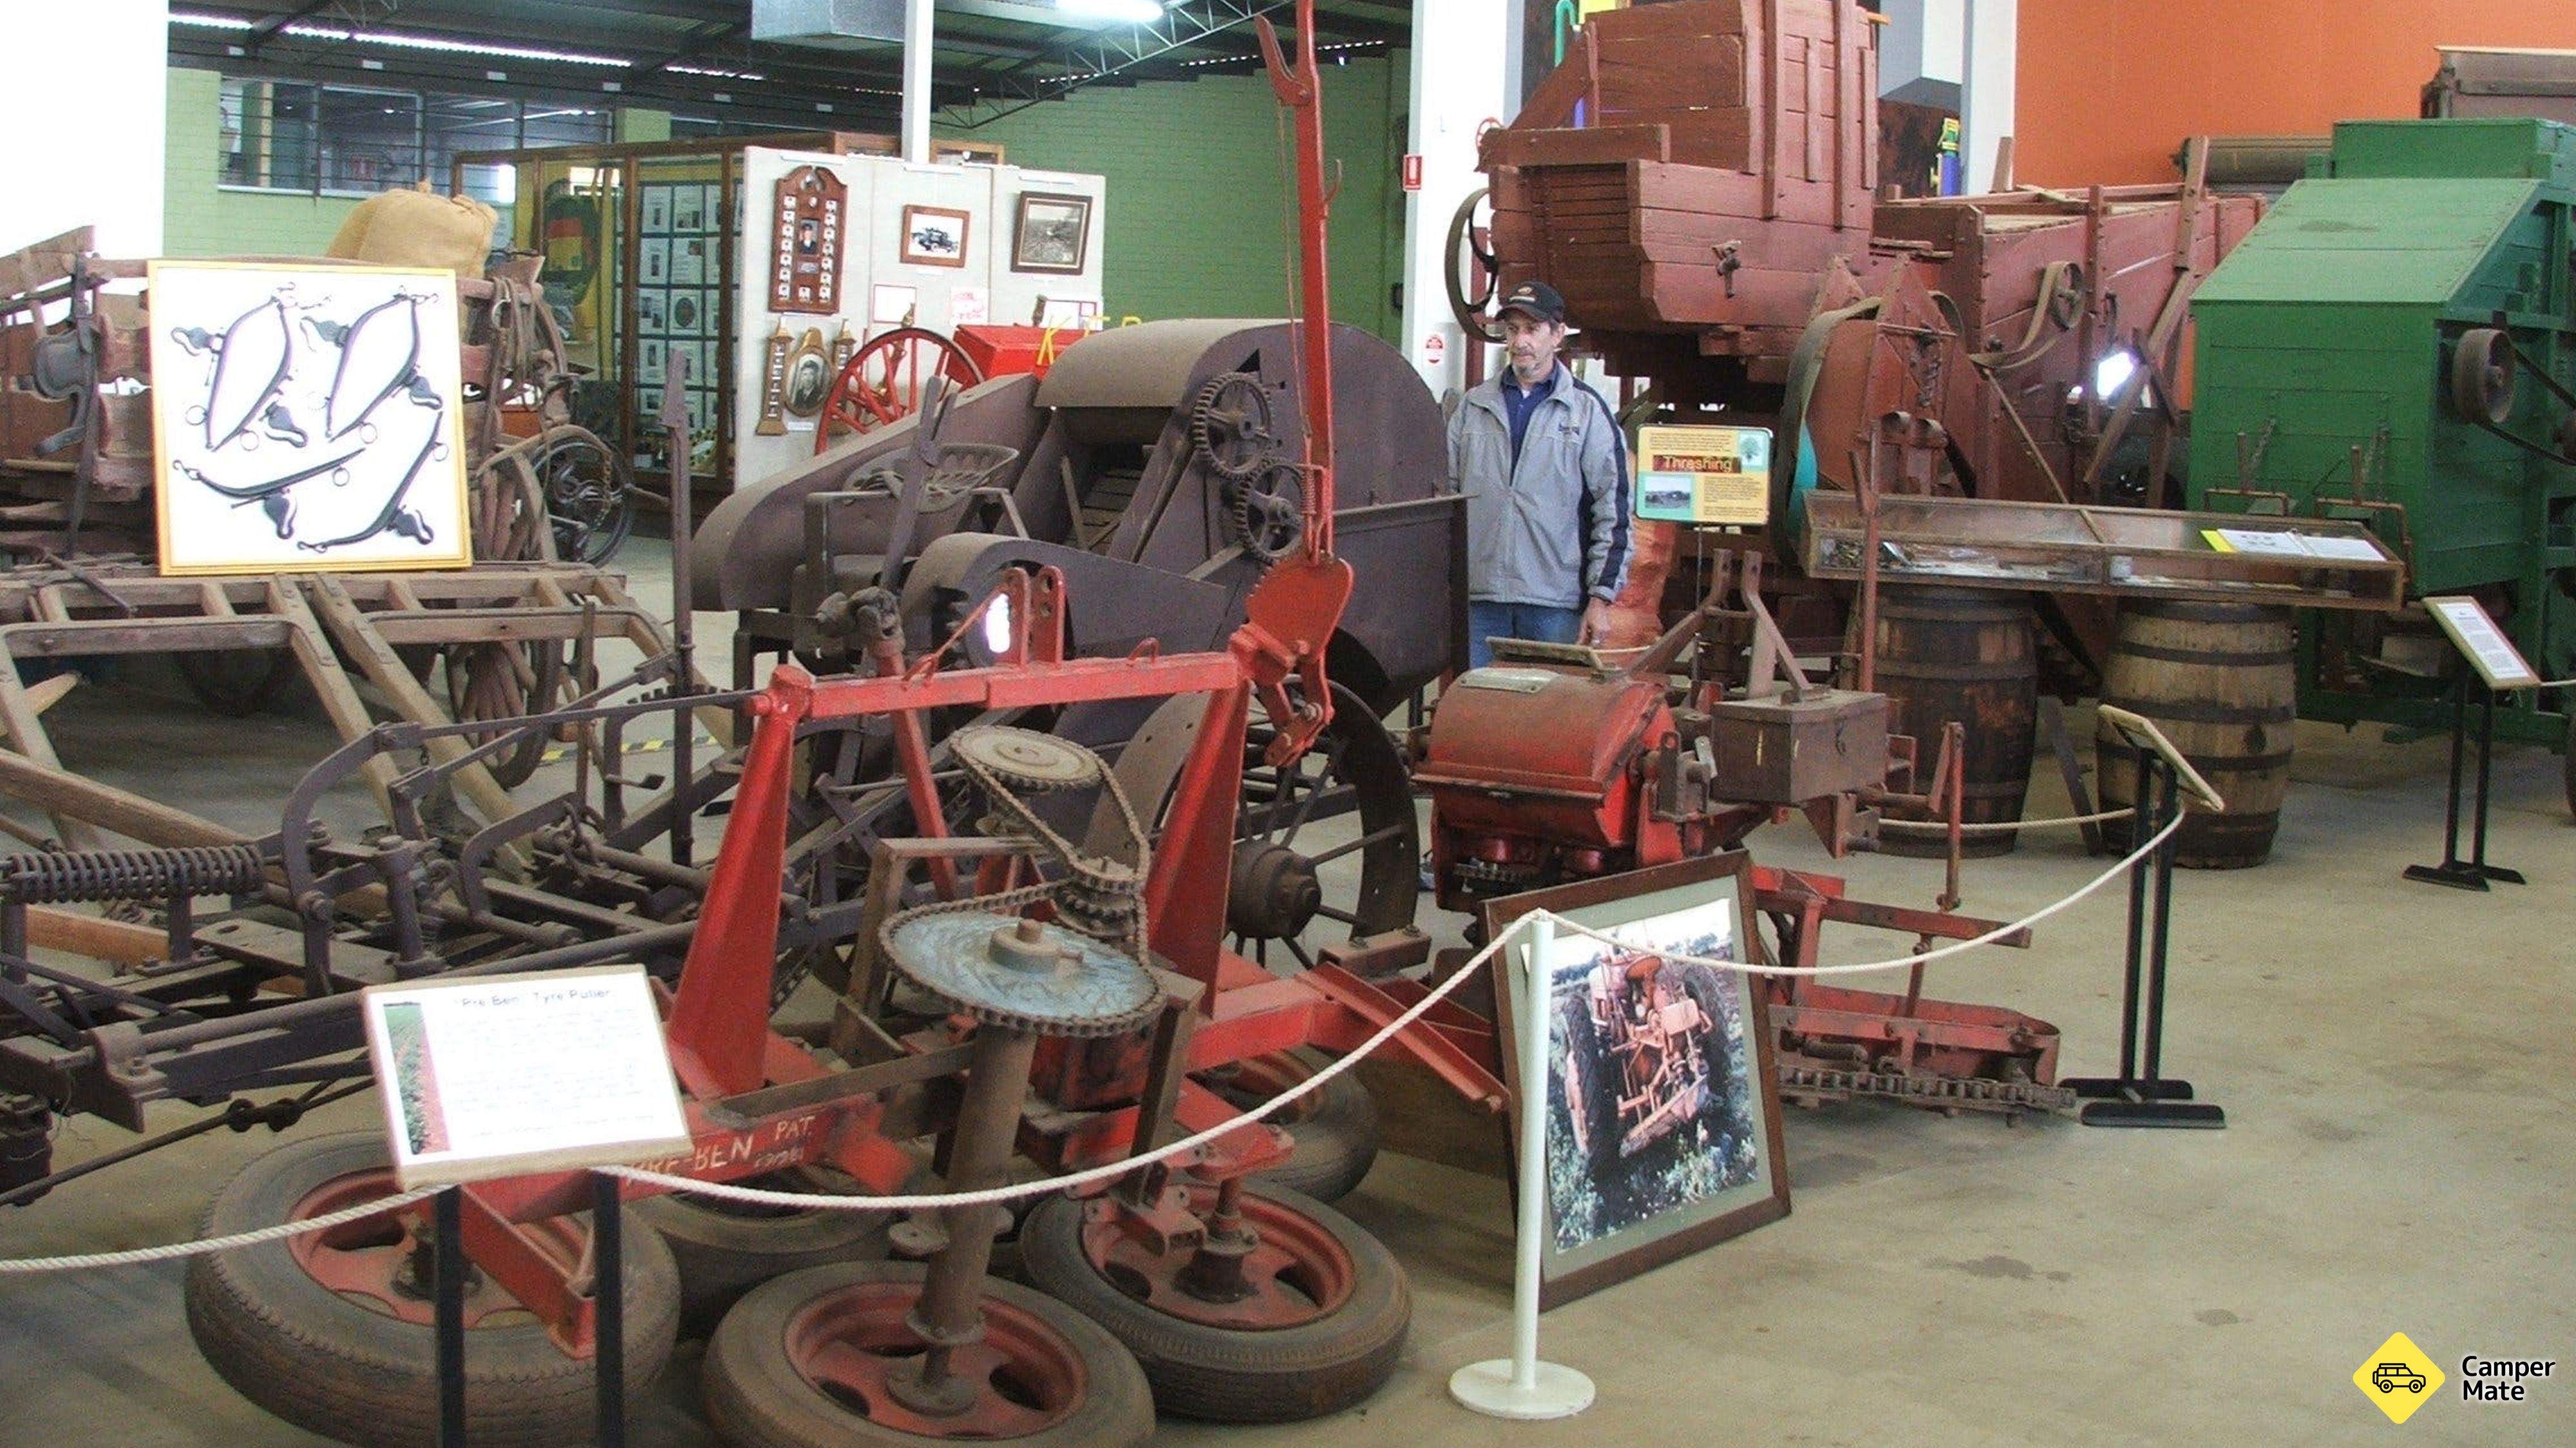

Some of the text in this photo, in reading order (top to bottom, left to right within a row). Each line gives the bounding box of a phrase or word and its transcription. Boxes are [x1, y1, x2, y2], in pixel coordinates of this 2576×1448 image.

[1663, 455, 1732, 473] Threshing
[533, 991, 564, 1005] Tyre
[568, 989, 611, 1000] Puller
